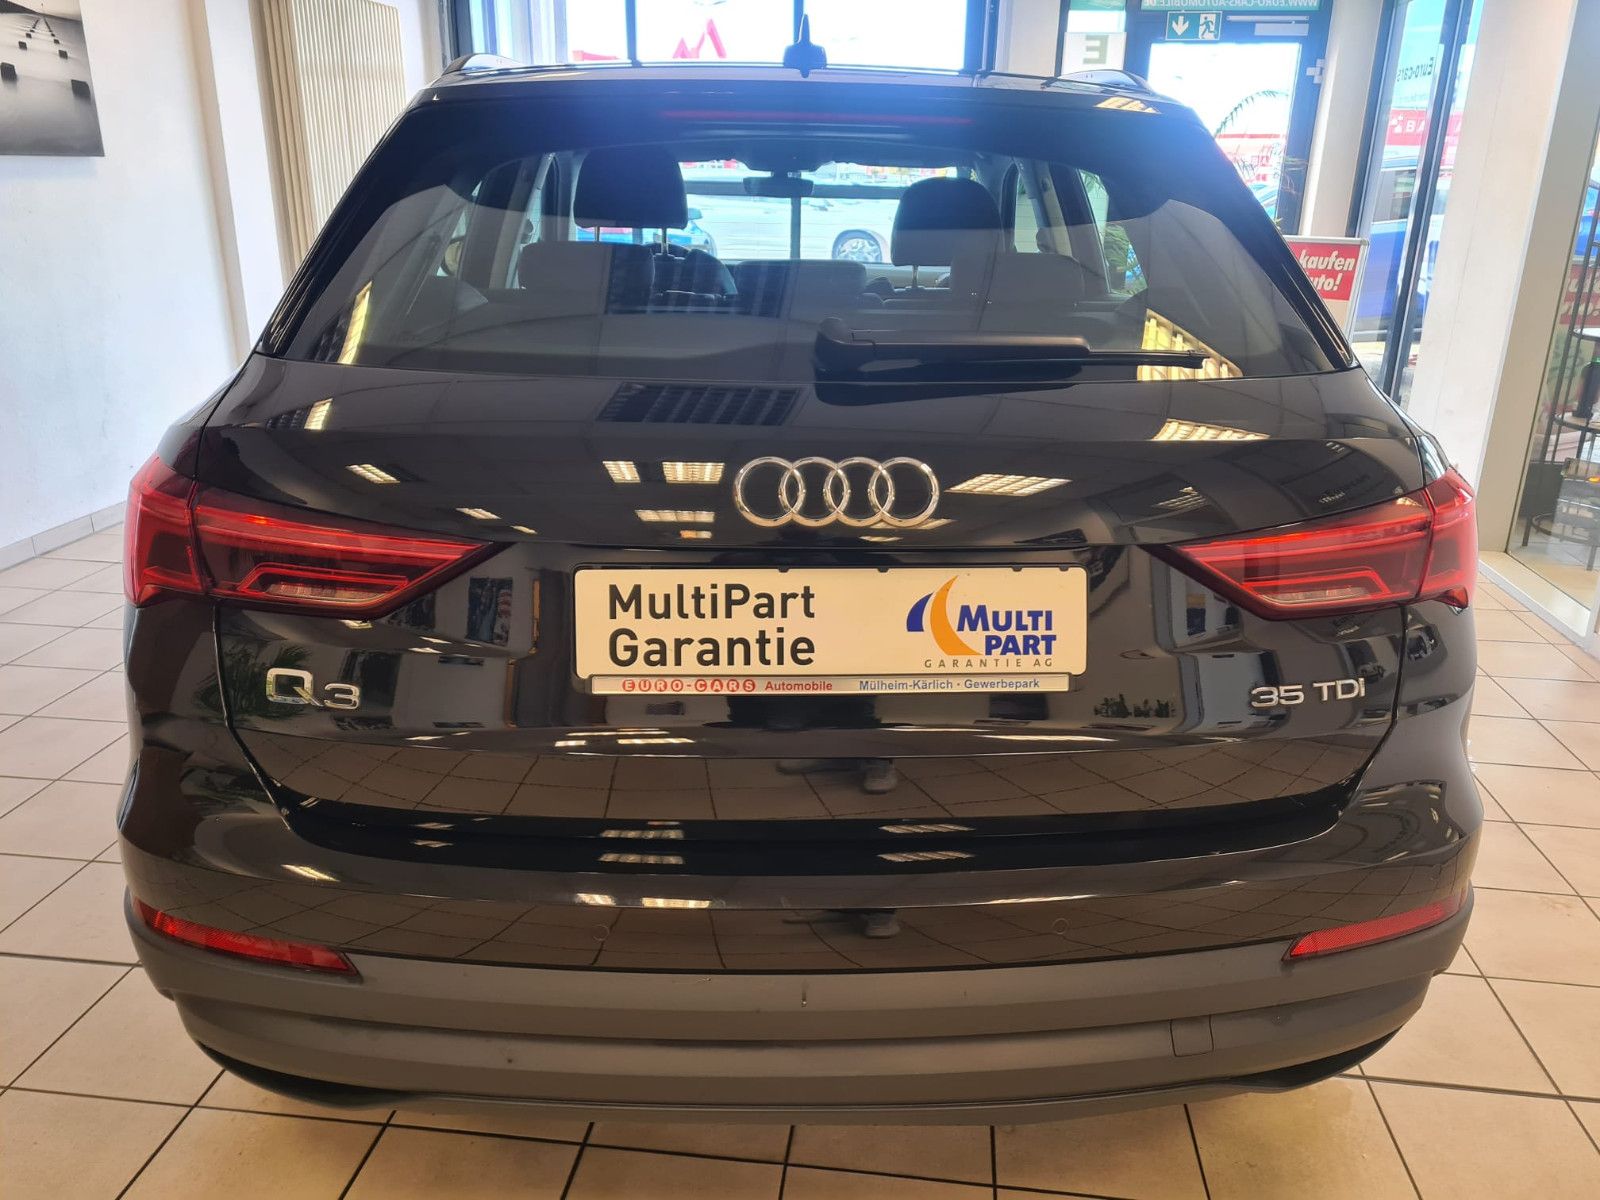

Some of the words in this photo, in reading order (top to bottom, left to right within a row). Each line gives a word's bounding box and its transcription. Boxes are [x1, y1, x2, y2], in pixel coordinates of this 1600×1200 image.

[1300, 249, 1356, 271] kaufen
[1308, 273, 1343, 291] uto!
[609, 583, 815, 619] MultiPart
[956, 604, 1053, 632] MULTI
[608, 627, 815, 667] Garantie
[985, 634, 1057, 656] PART
[924, 658, 1022, 668] GARANTIE
[1033, 657, 1053, 667] AG
[266, 668, 360, 709] Q3
[622, 679, 756, 692] EURO-CARS
[765, 681, 833, 691] Automobile
[859, 679, 953, 691] Mülheim-Kärlich
[964, 678, 1040, 690] Gewerbepark
[1250, 684, 1305, 708] 35
[1313, 678, 1366, 701] TDI
